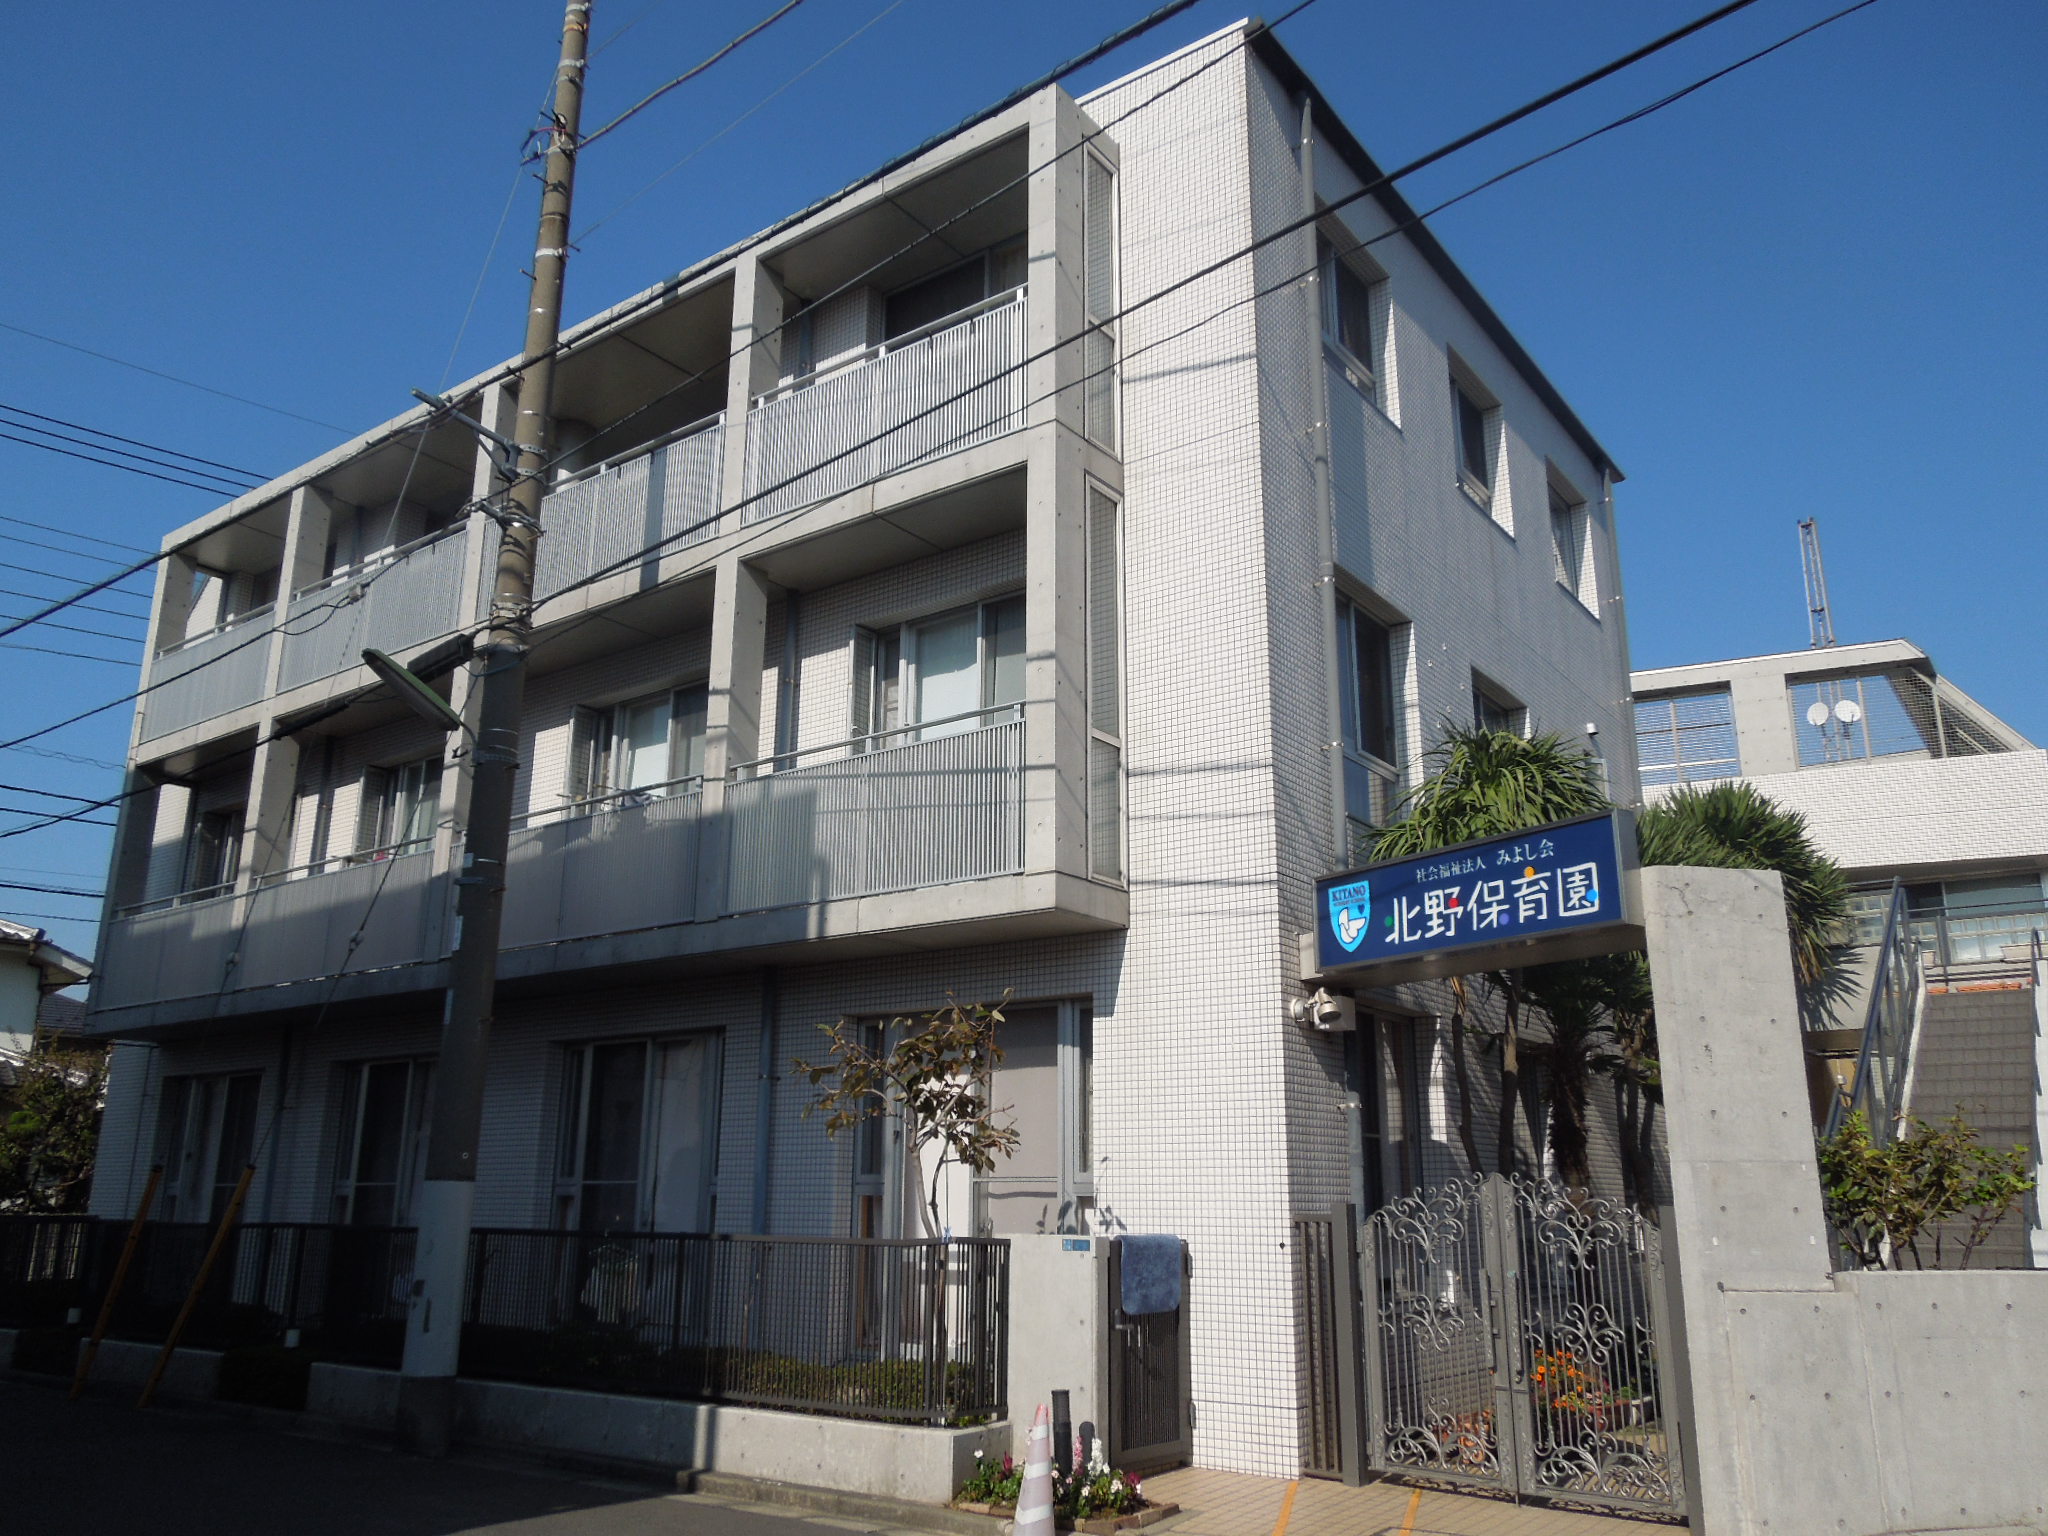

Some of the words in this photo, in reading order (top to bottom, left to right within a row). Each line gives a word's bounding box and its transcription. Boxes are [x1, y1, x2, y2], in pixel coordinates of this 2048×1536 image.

[1416, 856, 1486, 883] 社会福祉法人
[1496, 838, 1554, 865] みよし会
[1332, 885, 1366, 901] KITANO
[1385, 862, 1599, 944] 北野保育園
